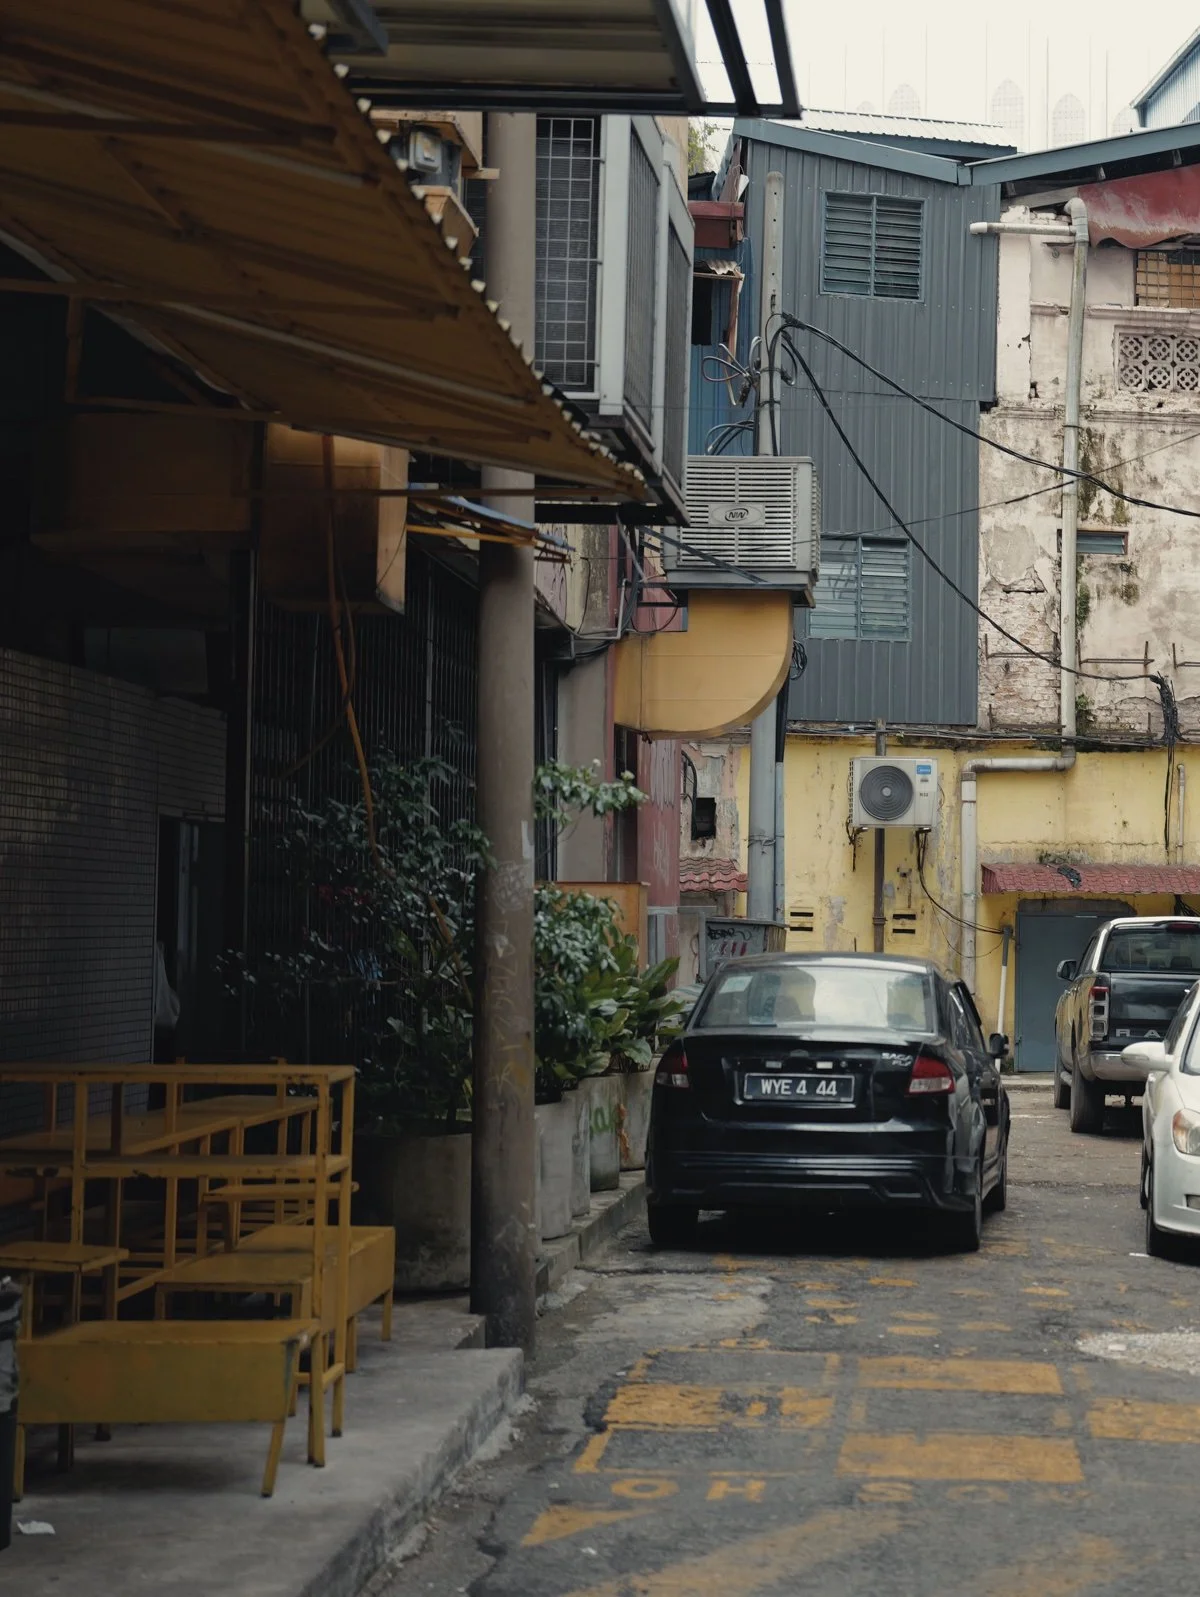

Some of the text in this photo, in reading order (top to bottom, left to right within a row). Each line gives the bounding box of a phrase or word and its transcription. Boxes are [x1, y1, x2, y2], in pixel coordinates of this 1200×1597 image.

[1115, 1028, 1161, 1038] RA
[881, 1052, 914, 1062] SAGA
[760, 1079, 838, 1097] WYE 4 44
